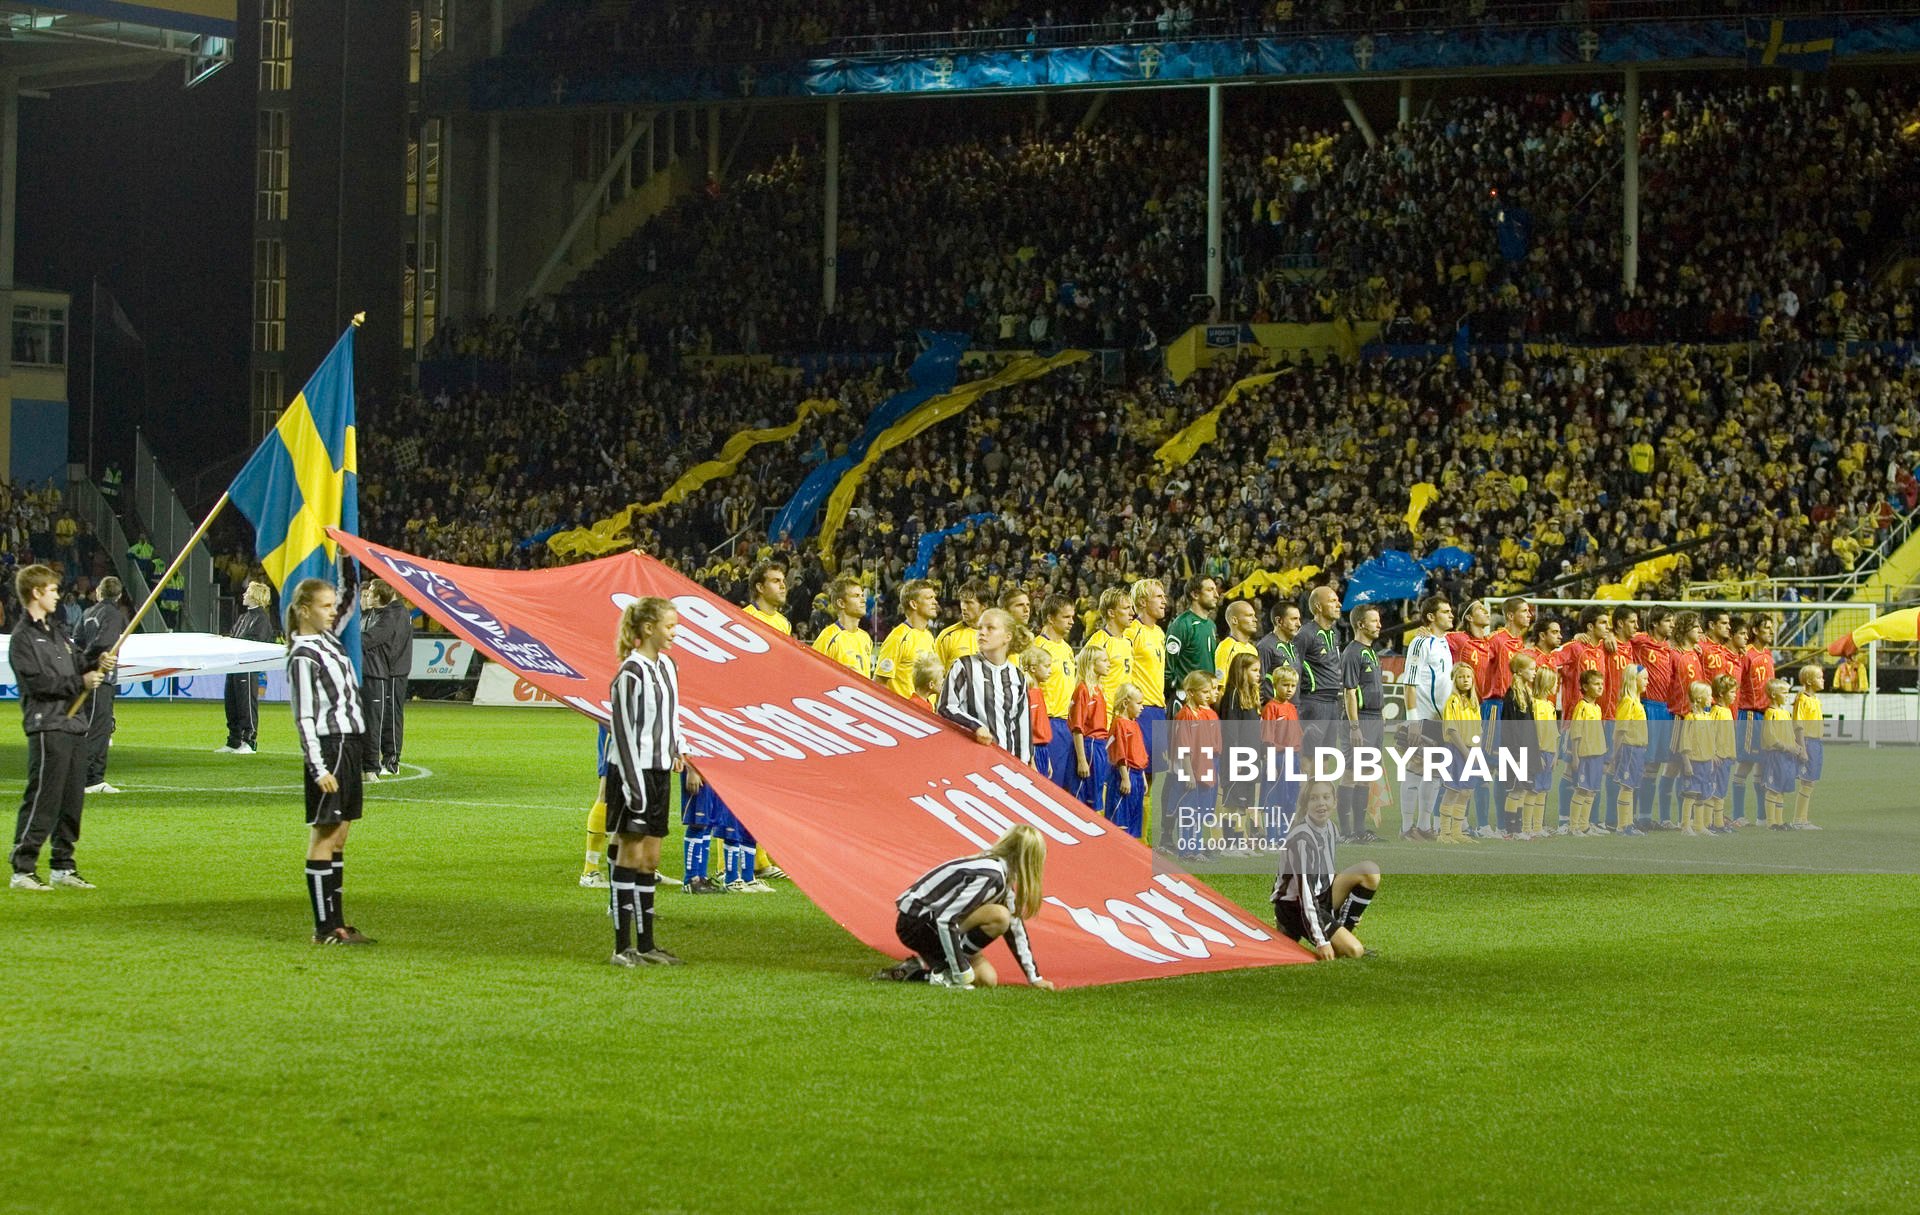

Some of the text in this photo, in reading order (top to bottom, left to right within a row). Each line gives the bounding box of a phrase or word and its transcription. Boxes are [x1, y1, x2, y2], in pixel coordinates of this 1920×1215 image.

[855, 654, 863, 671] 7
[1471, 650, 1478, 665] 4
[1614, 655, 1626, 670] 10
[1648, 650, 1656, 663] 6
[1707, 655, 1722, 668] 20
[1063, 661, 1070, 676] 6
[1124, 658, 1130, 674] 5
[1688, 664, 1695, 678] 5
[1755, 666, 1767, 681] 17
